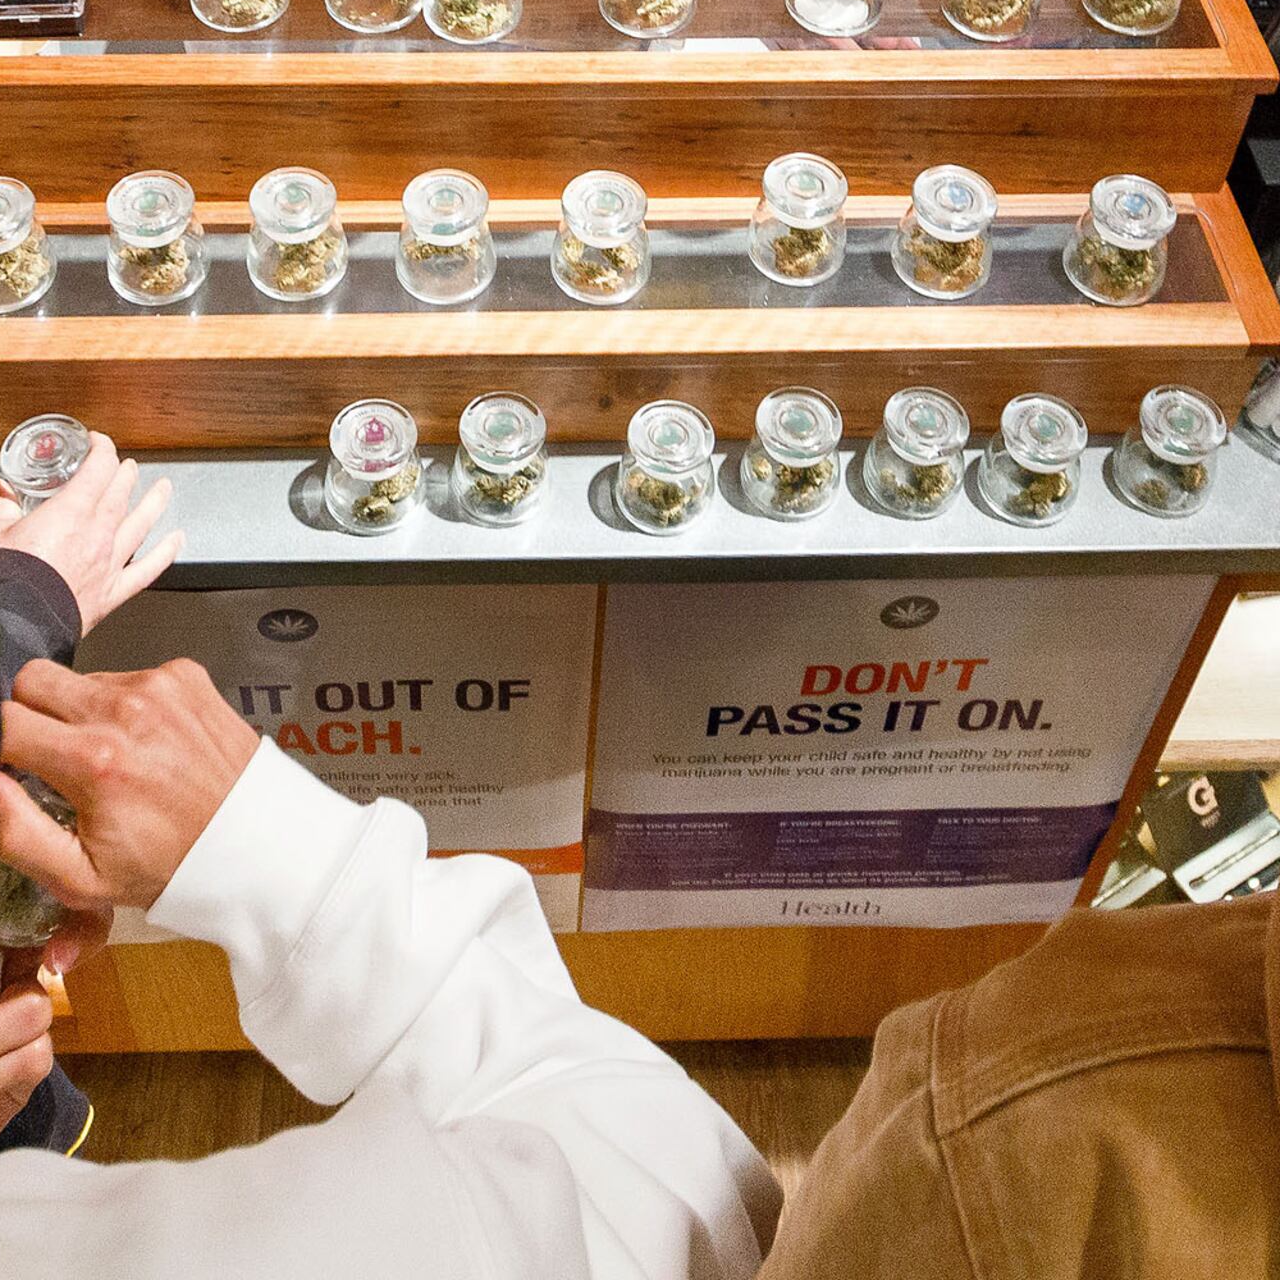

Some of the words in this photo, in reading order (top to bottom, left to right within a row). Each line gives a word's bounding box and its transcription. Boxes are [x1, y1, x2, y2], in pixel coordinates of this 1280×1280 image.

[800, 658, 989, 697] DON'T
[238, 685, 292, 716] IT
[314, 679, 433, 713] OUT
[455, 679, 531, 712] OF
[706, 701, 863, 737] PASS
[883, 700, 940, 732] IT
[957, 699, 1053, 731] ON.
[652, 753, 681, 764] You
[687, 755, 718, 764] can
[723, 753, 763, 765] keep
[769, 754, 802, 763] your
[809, 750, 847, 761] child
[853, 750, 887, 760] safe
[892, 749, 923, 760] and
[927, 748, 986, 761] healthy
[992, 747, 1012, 759] by
[1017, 748, 1043, 758] not
[319, 770, 381, 782] children
[385, 773, 419, 784] very
[662, 766, 742, 779] marijuana
[748, 766, 790, 776] while
[796, 767, 824, 777] you
[829, 766, 856, 775] are
[861, 763, 934, 776] pregnant
[938, 765, 956, 773] or
[376, 784, 410, 795] safe
[414, 784, 444, 794] and
[448, 783, 505, 797] healthy
[453, 797, 483, 807] that
[782, 901, 881, 916] Health
